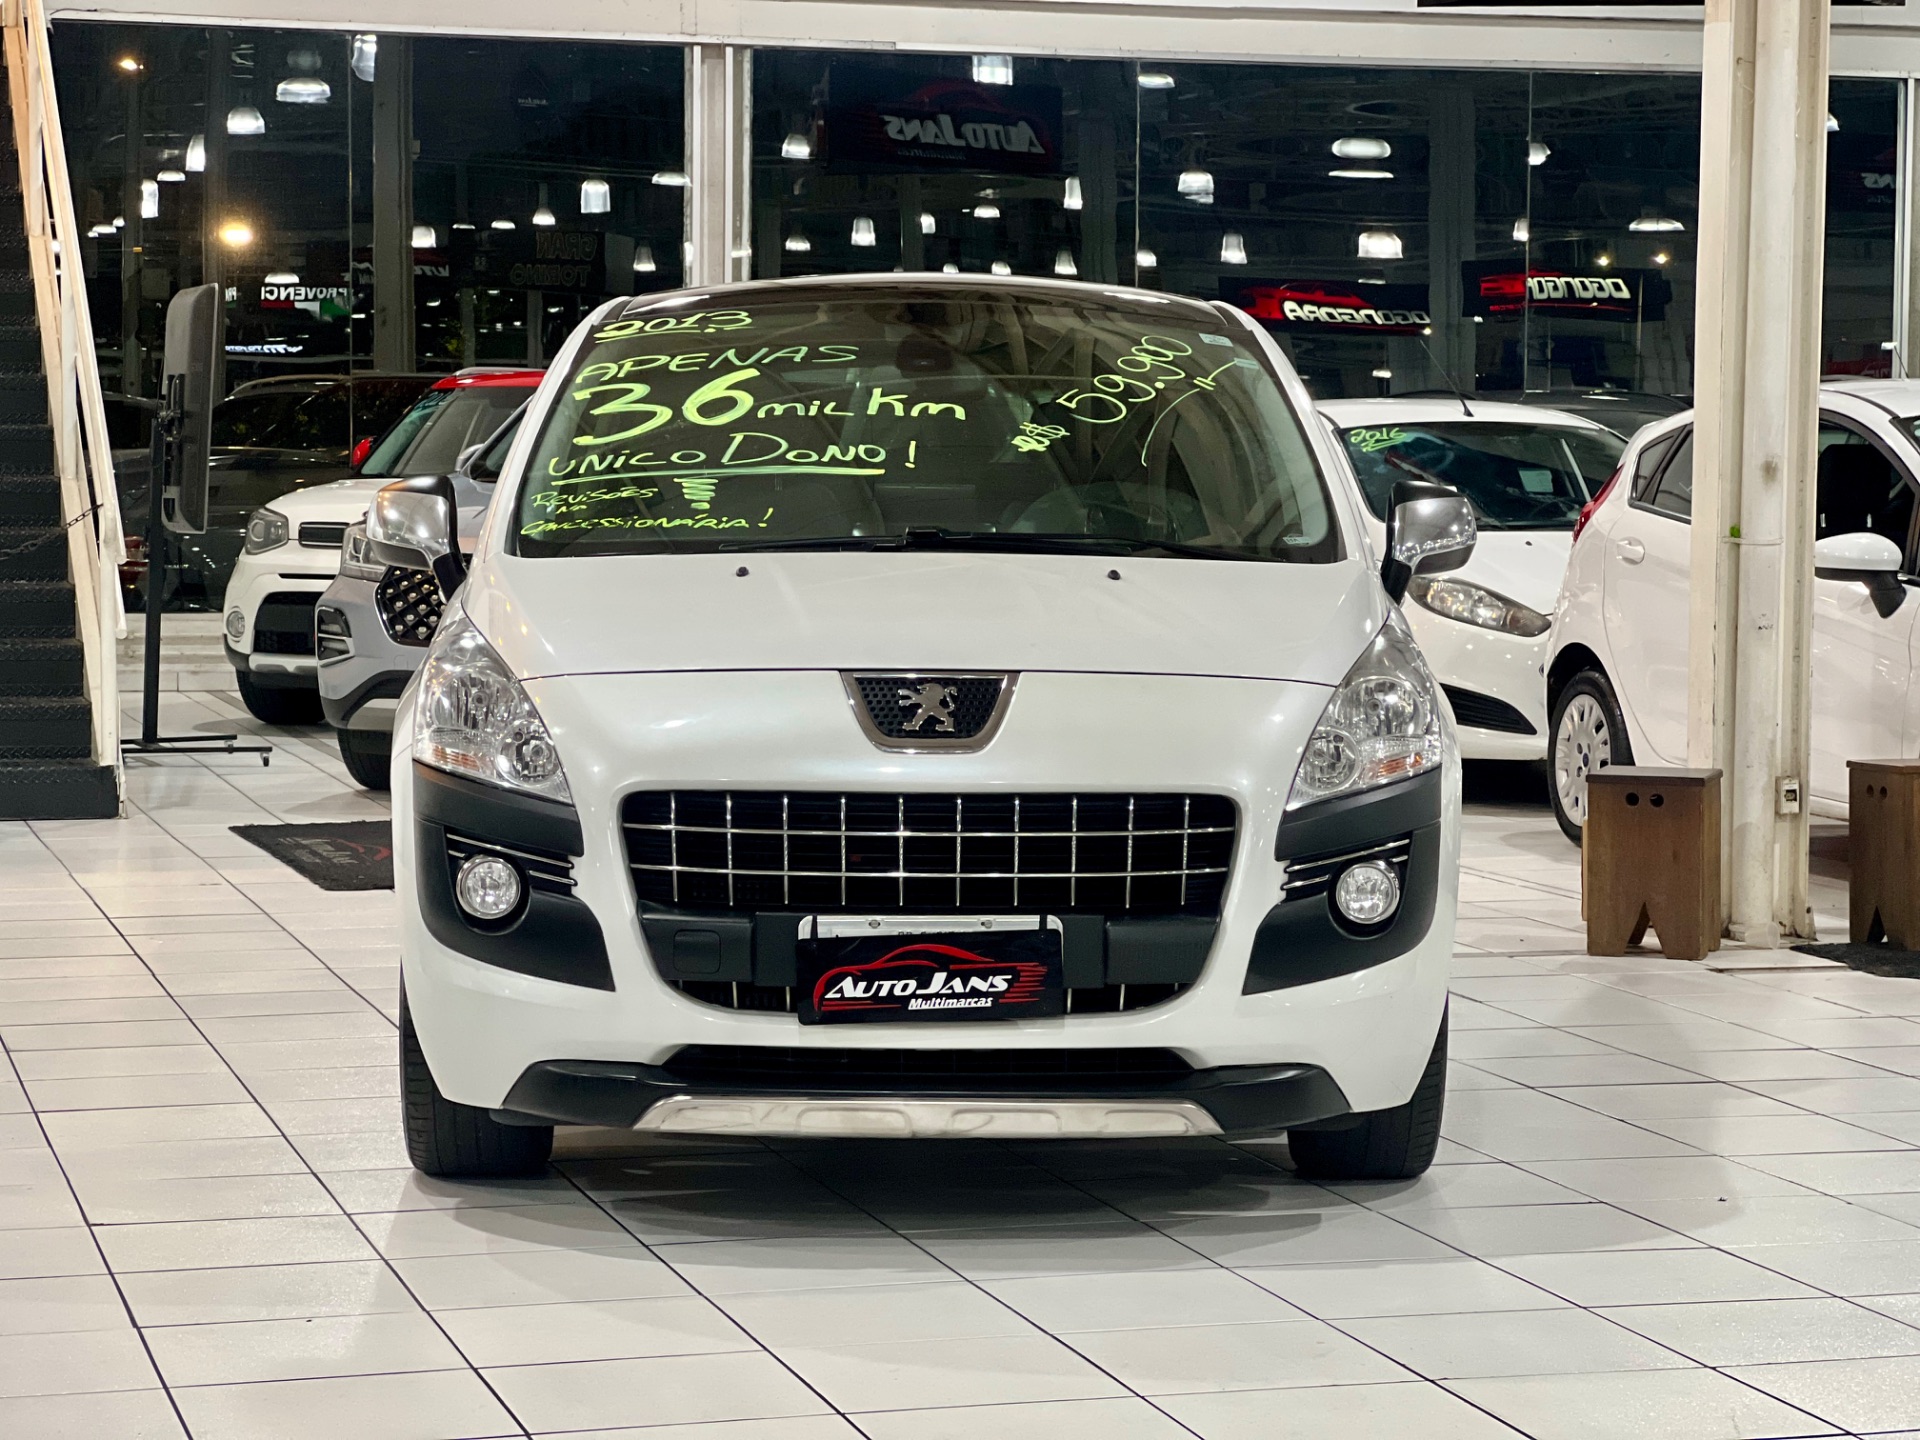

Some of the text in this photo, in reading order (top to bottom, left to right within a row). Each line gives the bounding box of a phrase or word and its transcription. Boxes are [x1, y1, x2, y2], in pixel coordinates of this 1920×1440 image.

[594, 310, 753, 340] 2013
[574, 345, 859, 384] APENAS
[572, 368, 761, 447] 36
[1350, 427, 1407, 444] 2016
[824, 971, 1013, 999] AUTO JANS
[907, 996, 993, 1010] Multimarcas
